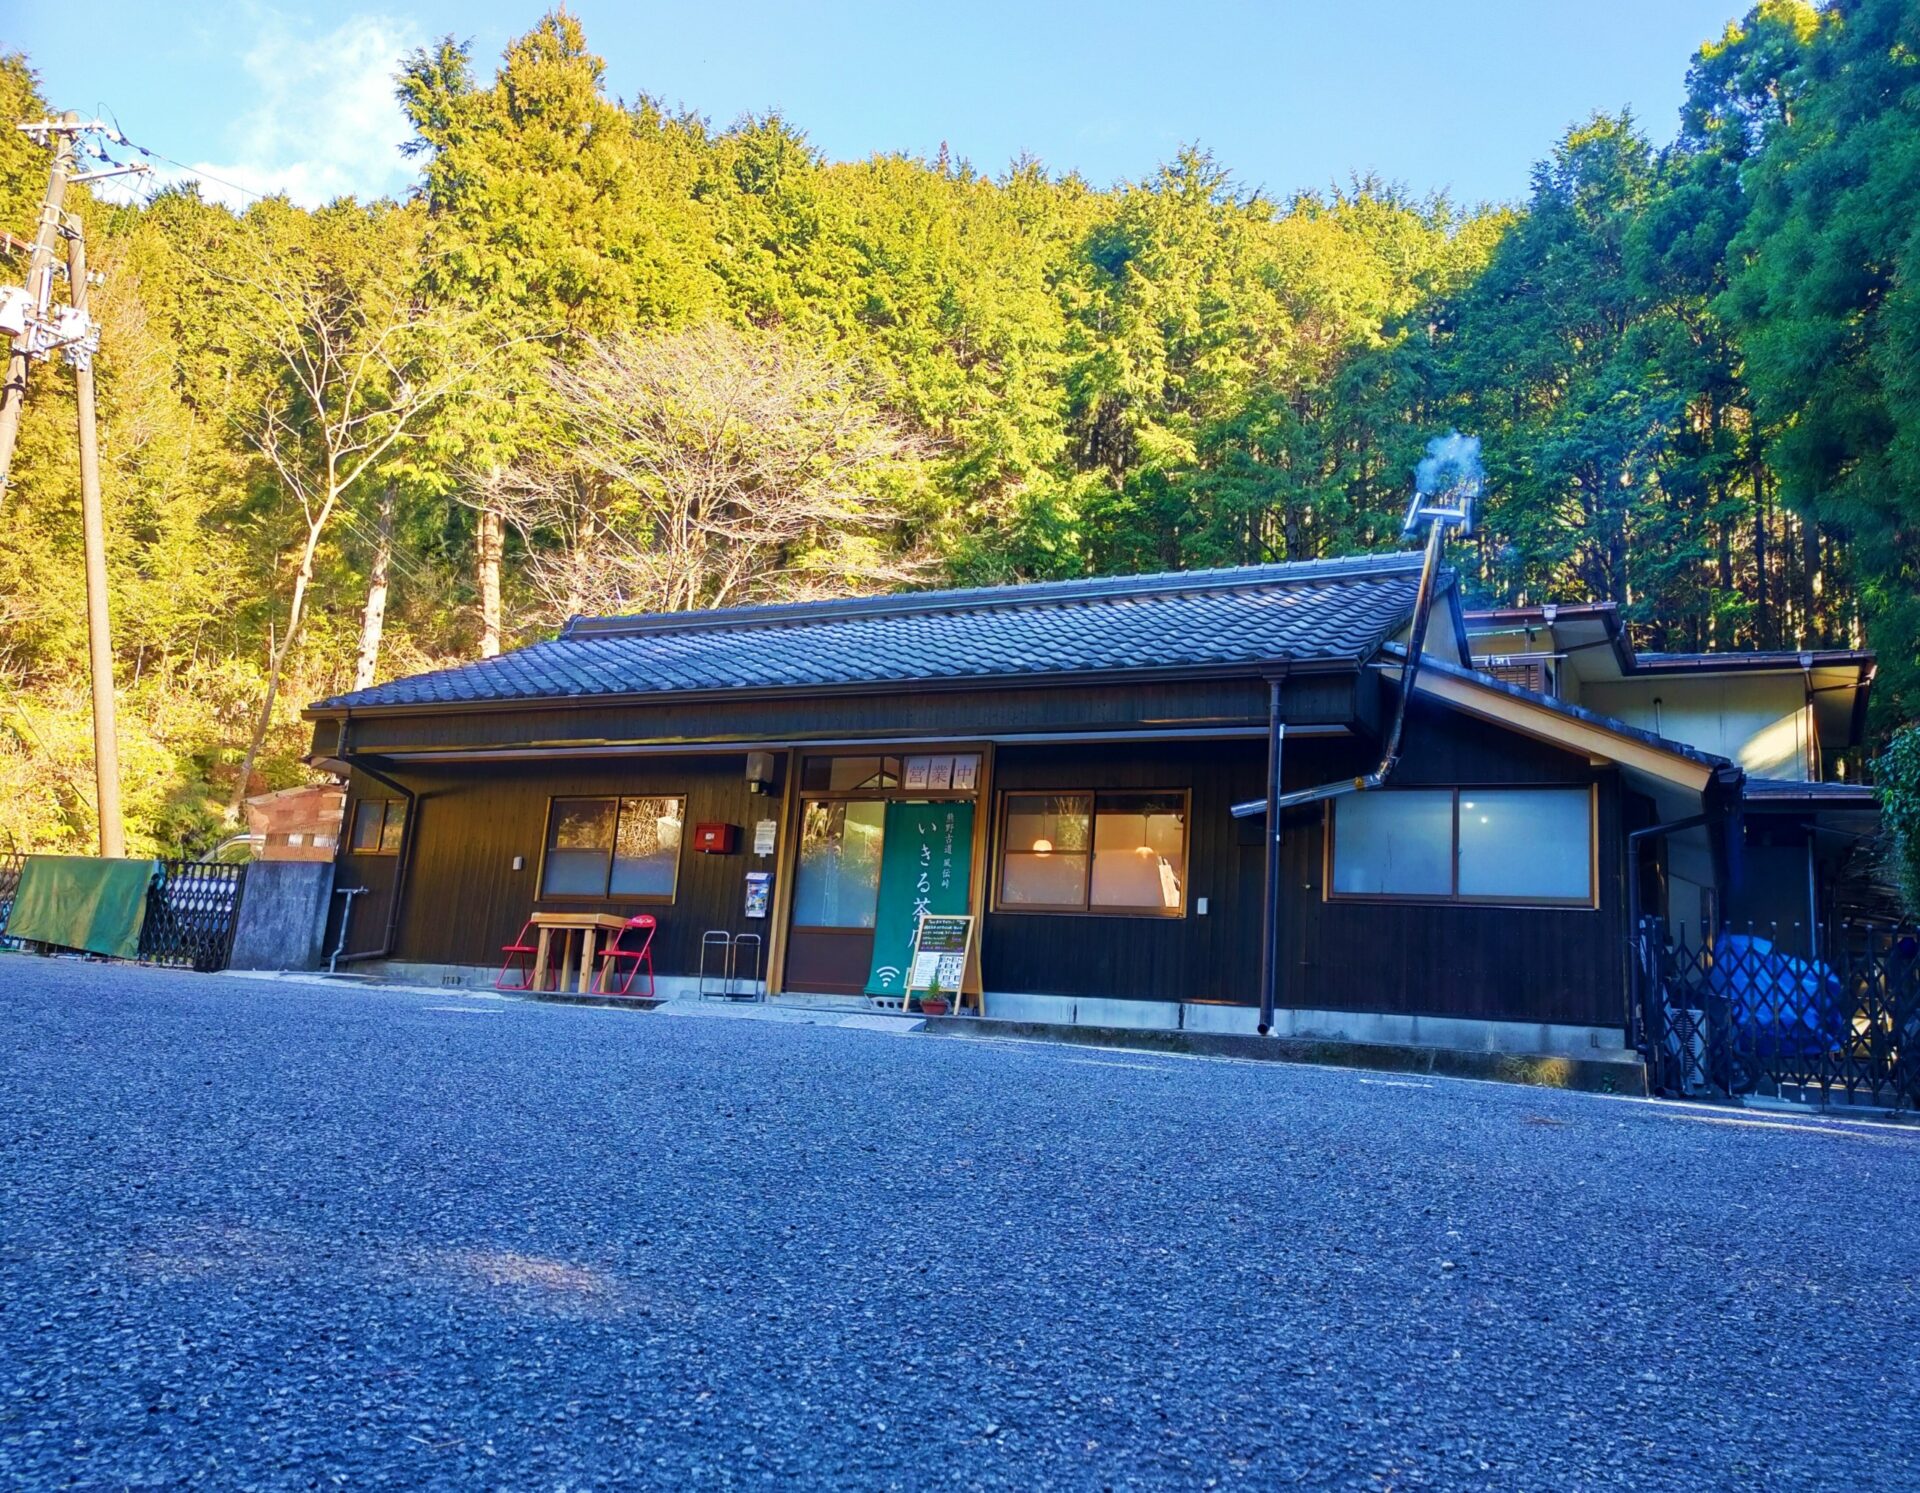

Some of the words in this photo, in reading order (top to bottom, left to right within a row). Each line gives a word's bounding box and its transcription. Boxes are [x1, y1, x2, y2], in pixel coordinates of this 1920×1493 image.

[909, 764, 972, 784] 営業中
[944, 812, 954, 855] 熊野古道
